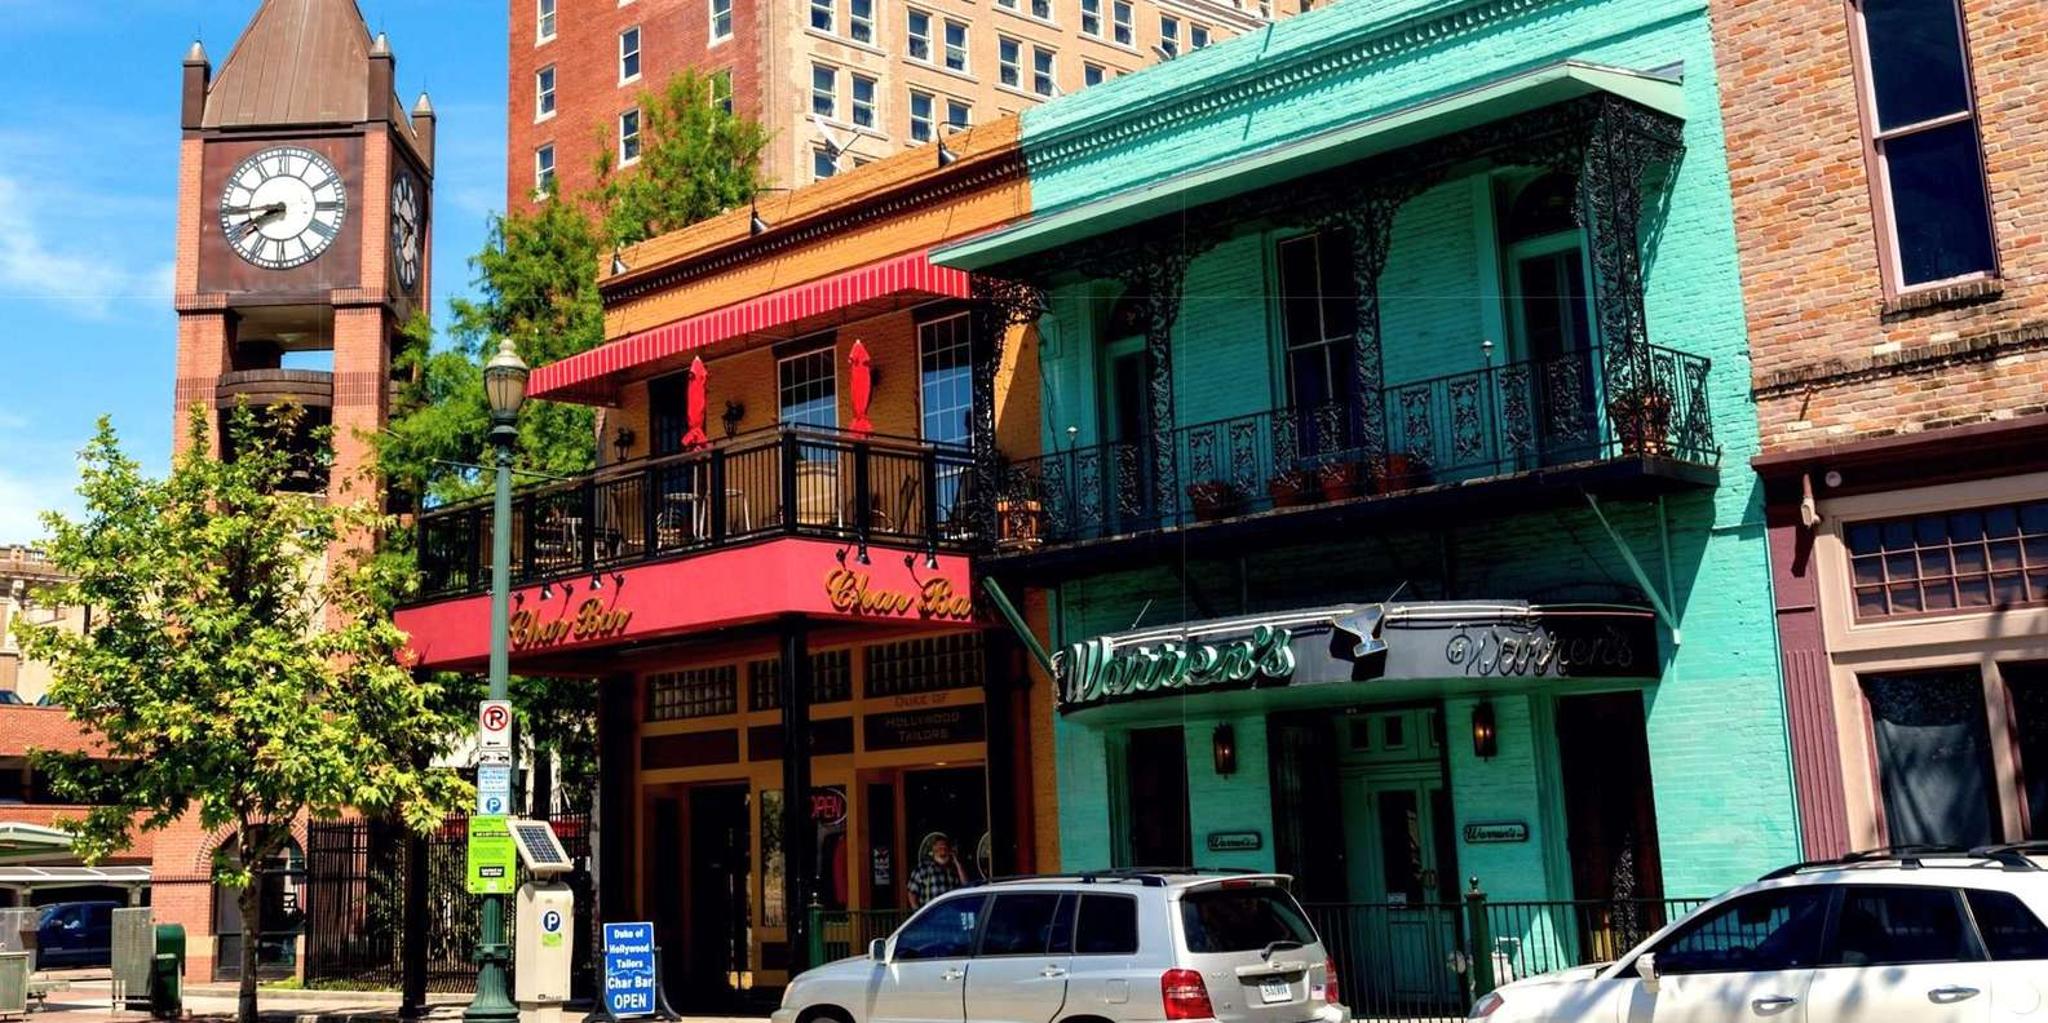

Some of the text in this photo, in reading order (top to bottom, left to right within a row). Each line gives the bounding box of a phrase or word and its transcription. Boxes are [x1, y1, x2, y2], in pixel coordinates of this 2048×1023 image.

[826, 569, 971, 618] Char Ba
[509, 598, 632, 648] Char Bar
[1446, 624, 1634, 677] Warren's
[1060, 624, 1296, 703] Warren's
[614, 929, 644, 939] Duke of
[608, 943, 650, 955] Hollywood
[616, 959, 643, 969] Tailors
[608, 976, 653, 989] Char Bar
[614, 993, 647, 1009] OPEN
